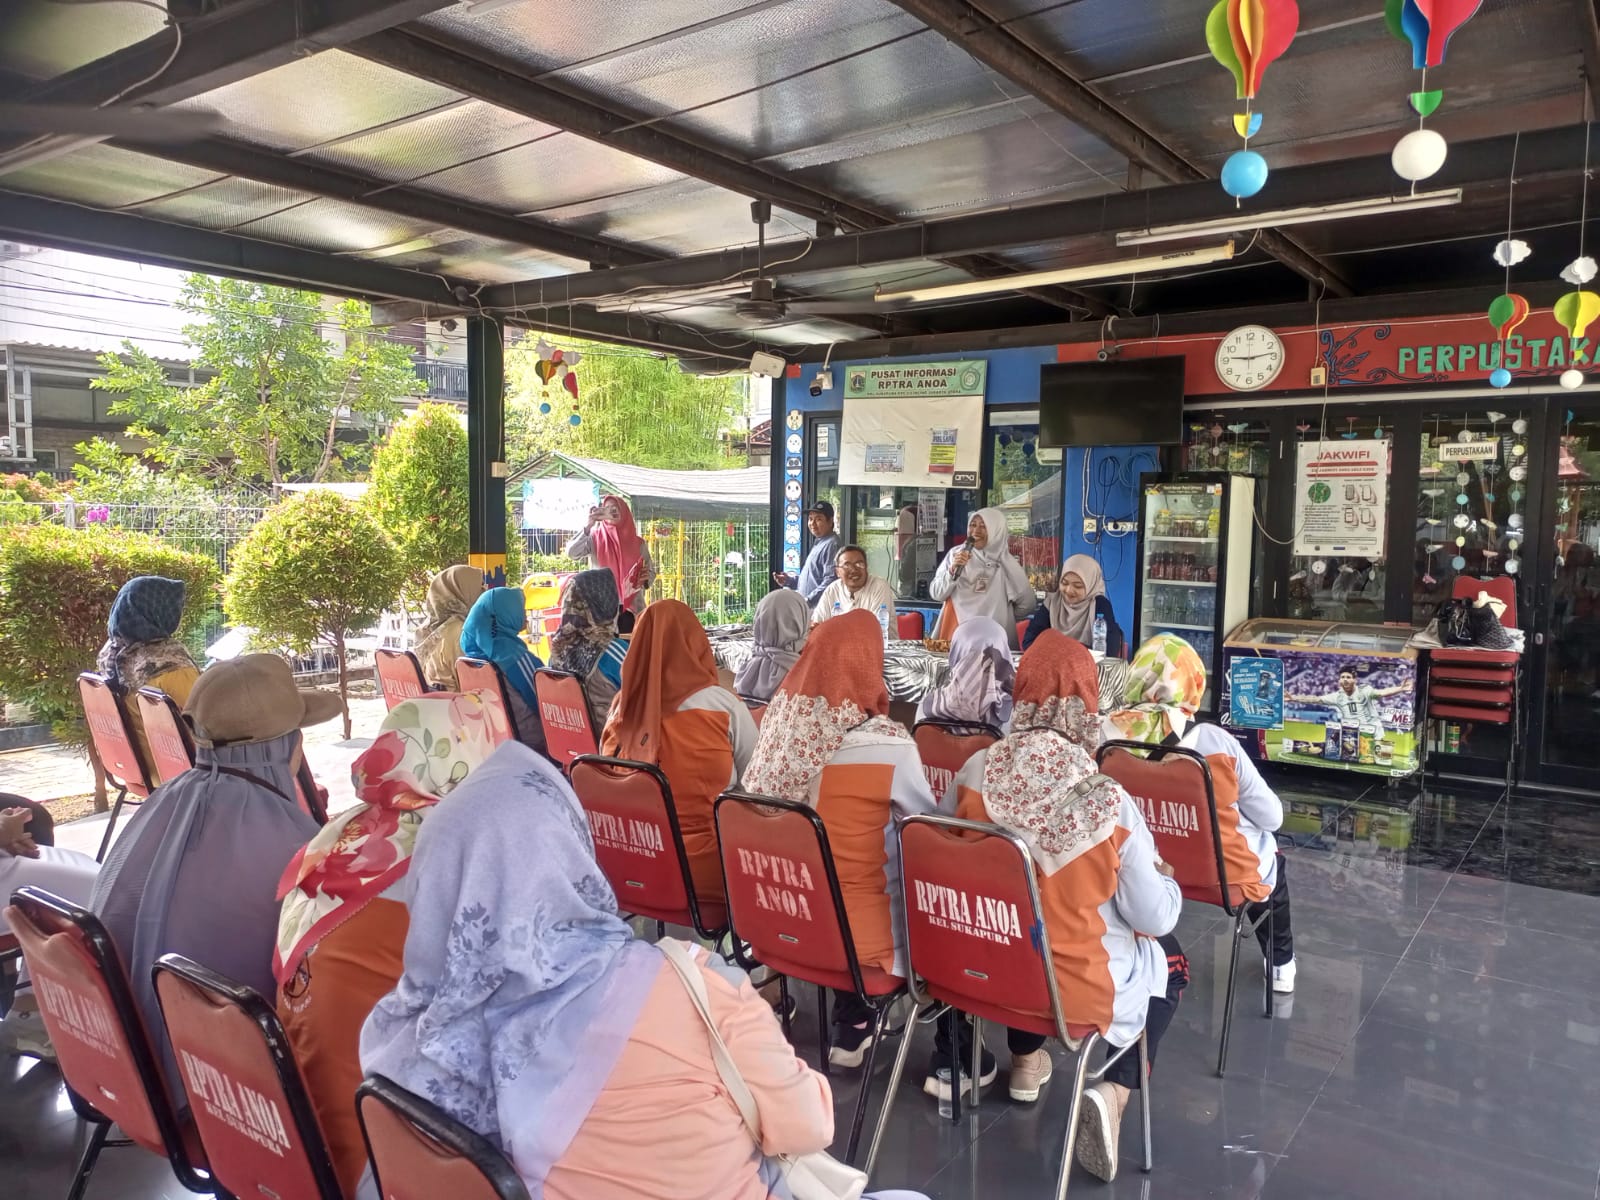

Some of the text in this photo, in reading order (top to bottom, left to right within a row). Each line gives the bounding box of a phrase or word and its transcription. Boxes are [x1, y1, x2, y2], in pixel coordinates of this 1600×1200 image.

[1235, 336, 1241, 345] 11
[1246, 332, 1255, 341] 12
[1226, 345, 1236, 353] 10
[1267, 341, 1274, 349] 2
[1270, 352, 1277, 360] 3
[1398, 334, 1600, 374] PERPUSTAK
[1222, 357, 1230, 365] 9
[871, 368, 957, 379] PUSAT INFORMASI
[1234, 374, 1241, 382] 7
[878, 379, 947, 389] RPTRA ANOA
[1245, 377, 1253, 385] 6
[1316, 450, 1371, 460] JAKWIFI
[1446, 446, 1493, 456] PERPUSTAKAAN
[1348, 702, 1358, 713] 10
[1159, 800, 1200, 831] ANOA
[629, 819, 665, 851] ANOA
[612, 842, 656, 858] SUKAPURA
[737, 847, 815, 890] RPTRA
[755, 882, 813, 921] ANOA
[914, 879, 1022, 938] RPTRA ANOA
[951, 922, 1011, 946] SUKAPURA
[180, 1049, 292, 1151] RPTRA ANOA
